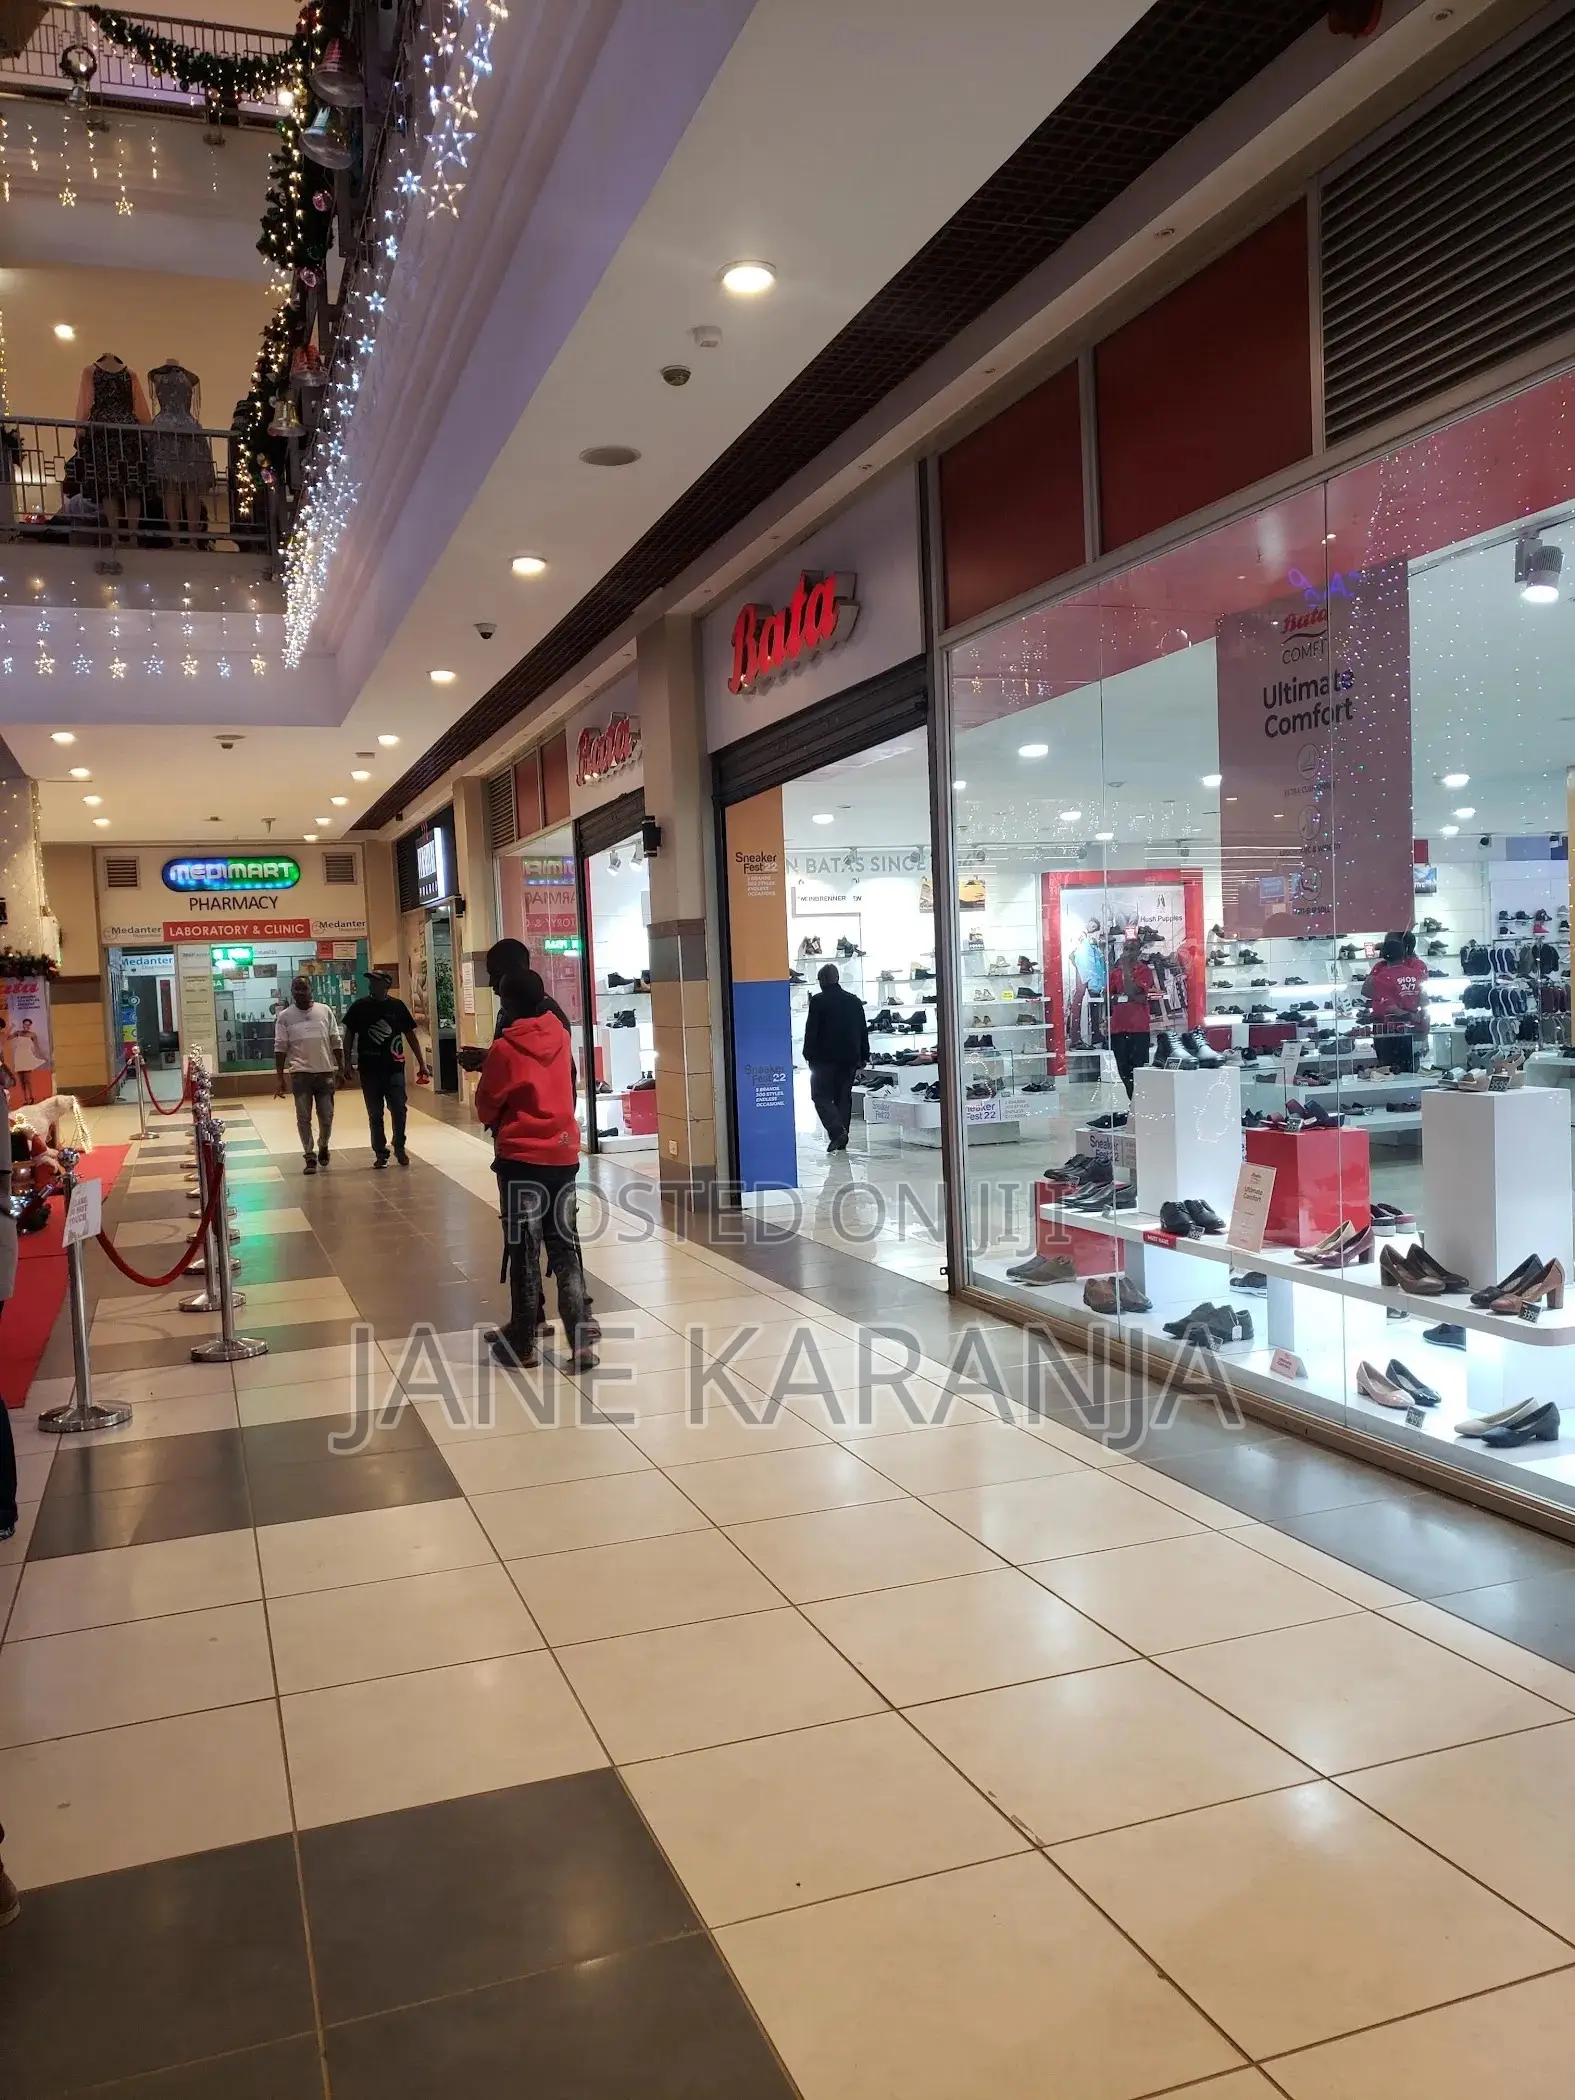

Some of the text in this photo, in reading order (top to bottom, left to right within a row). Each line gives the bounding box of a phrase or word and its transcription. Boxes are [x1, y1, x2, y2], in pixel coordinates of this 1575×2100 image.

[729, 571, 842, 694] Bata
[1263, 668, 1354, 709] Ultimate
[1265, 698, 1353, 738] Comfort
[576, 713, 637, 787] Bata
[735, 851, 777, 863] Sneaker
[743, 862, 778, 875] Fest 22
[870, 855, 927, 873] SINCE
[170, 862, 294, 880] MEDIMART
[189, 896, 278, 911] PHARMACY
[319, 920, 366, 929] Medanter
[1158, 914, 1183, 923] Puppies
[111, 925, 162, 935] Medanter
[169, 923, 305, 937] LABORATORY & CLINIC
[1397, 976, 1417, 985] SHOP
[772, 1073, 787, 1082] 22
[966, 1102, 995, 1112] neaker
[984, 1110, 996, 1120] 22
